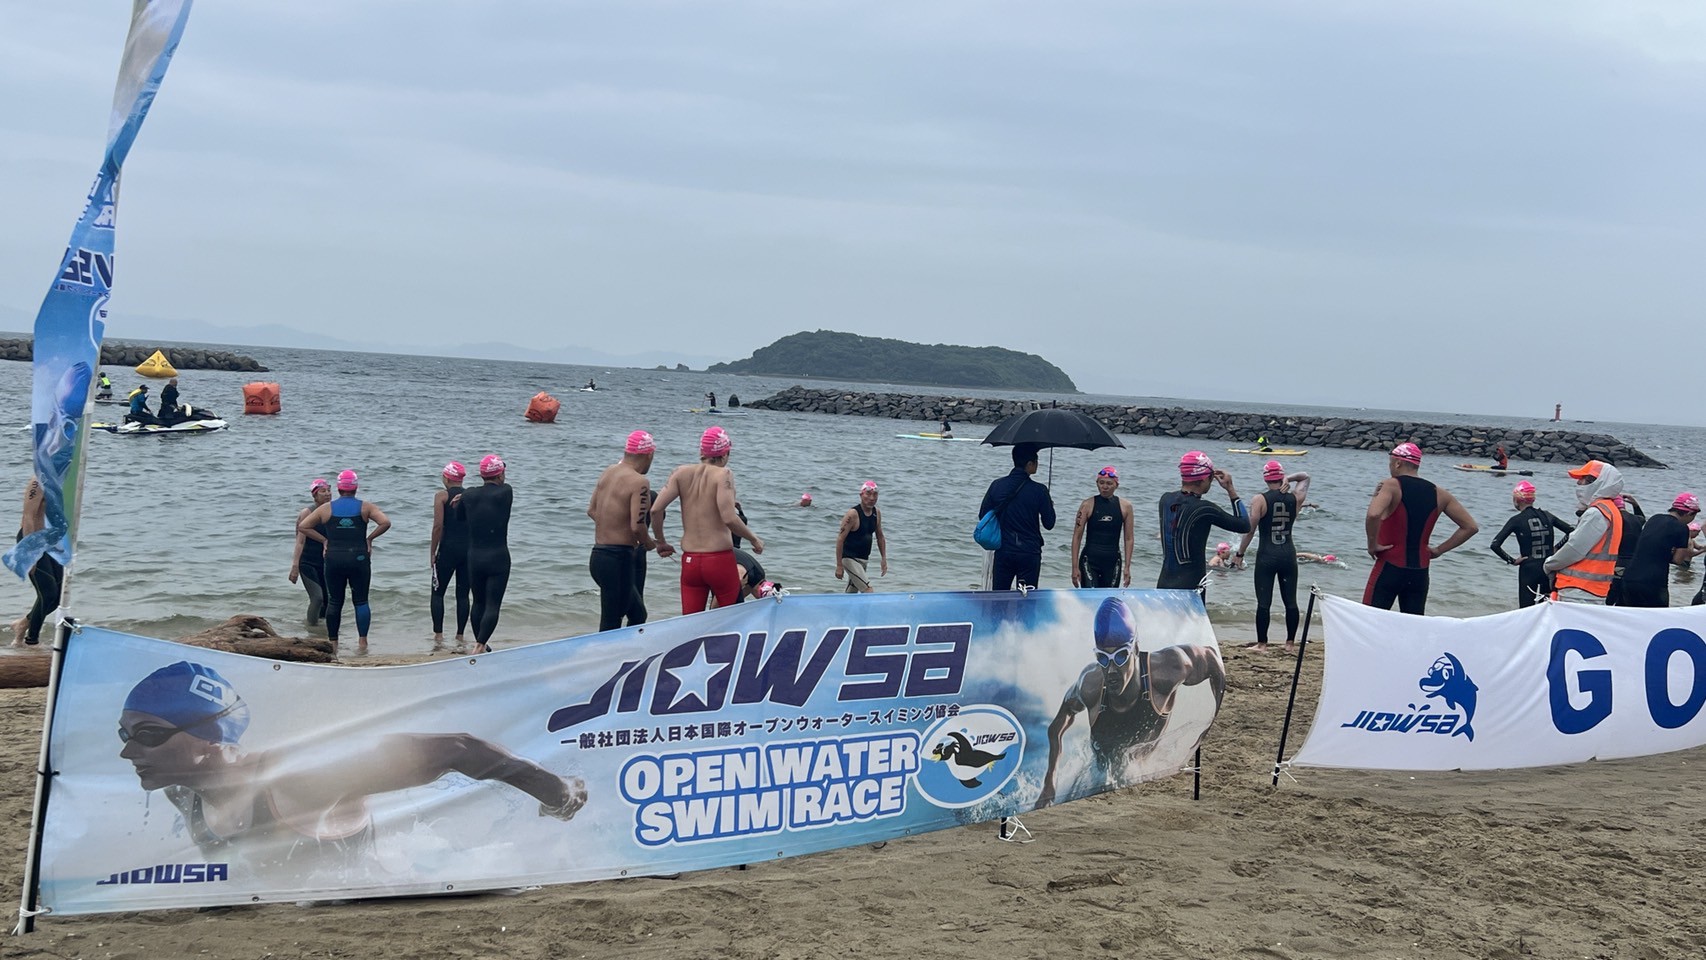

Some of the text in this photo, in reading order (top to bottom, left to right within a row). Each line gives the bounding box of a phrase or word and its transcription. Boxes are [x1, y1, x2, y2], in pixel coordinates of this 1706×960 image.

[560, 703, 961, 750] 一般社団法人日本国際オープンウォータースイミング協会
[623, 737, 918, 800] OPEN WATER
[638, 778, 905, 842] SWIM RACE
[96, 862, 229, 885] JIOWSA
